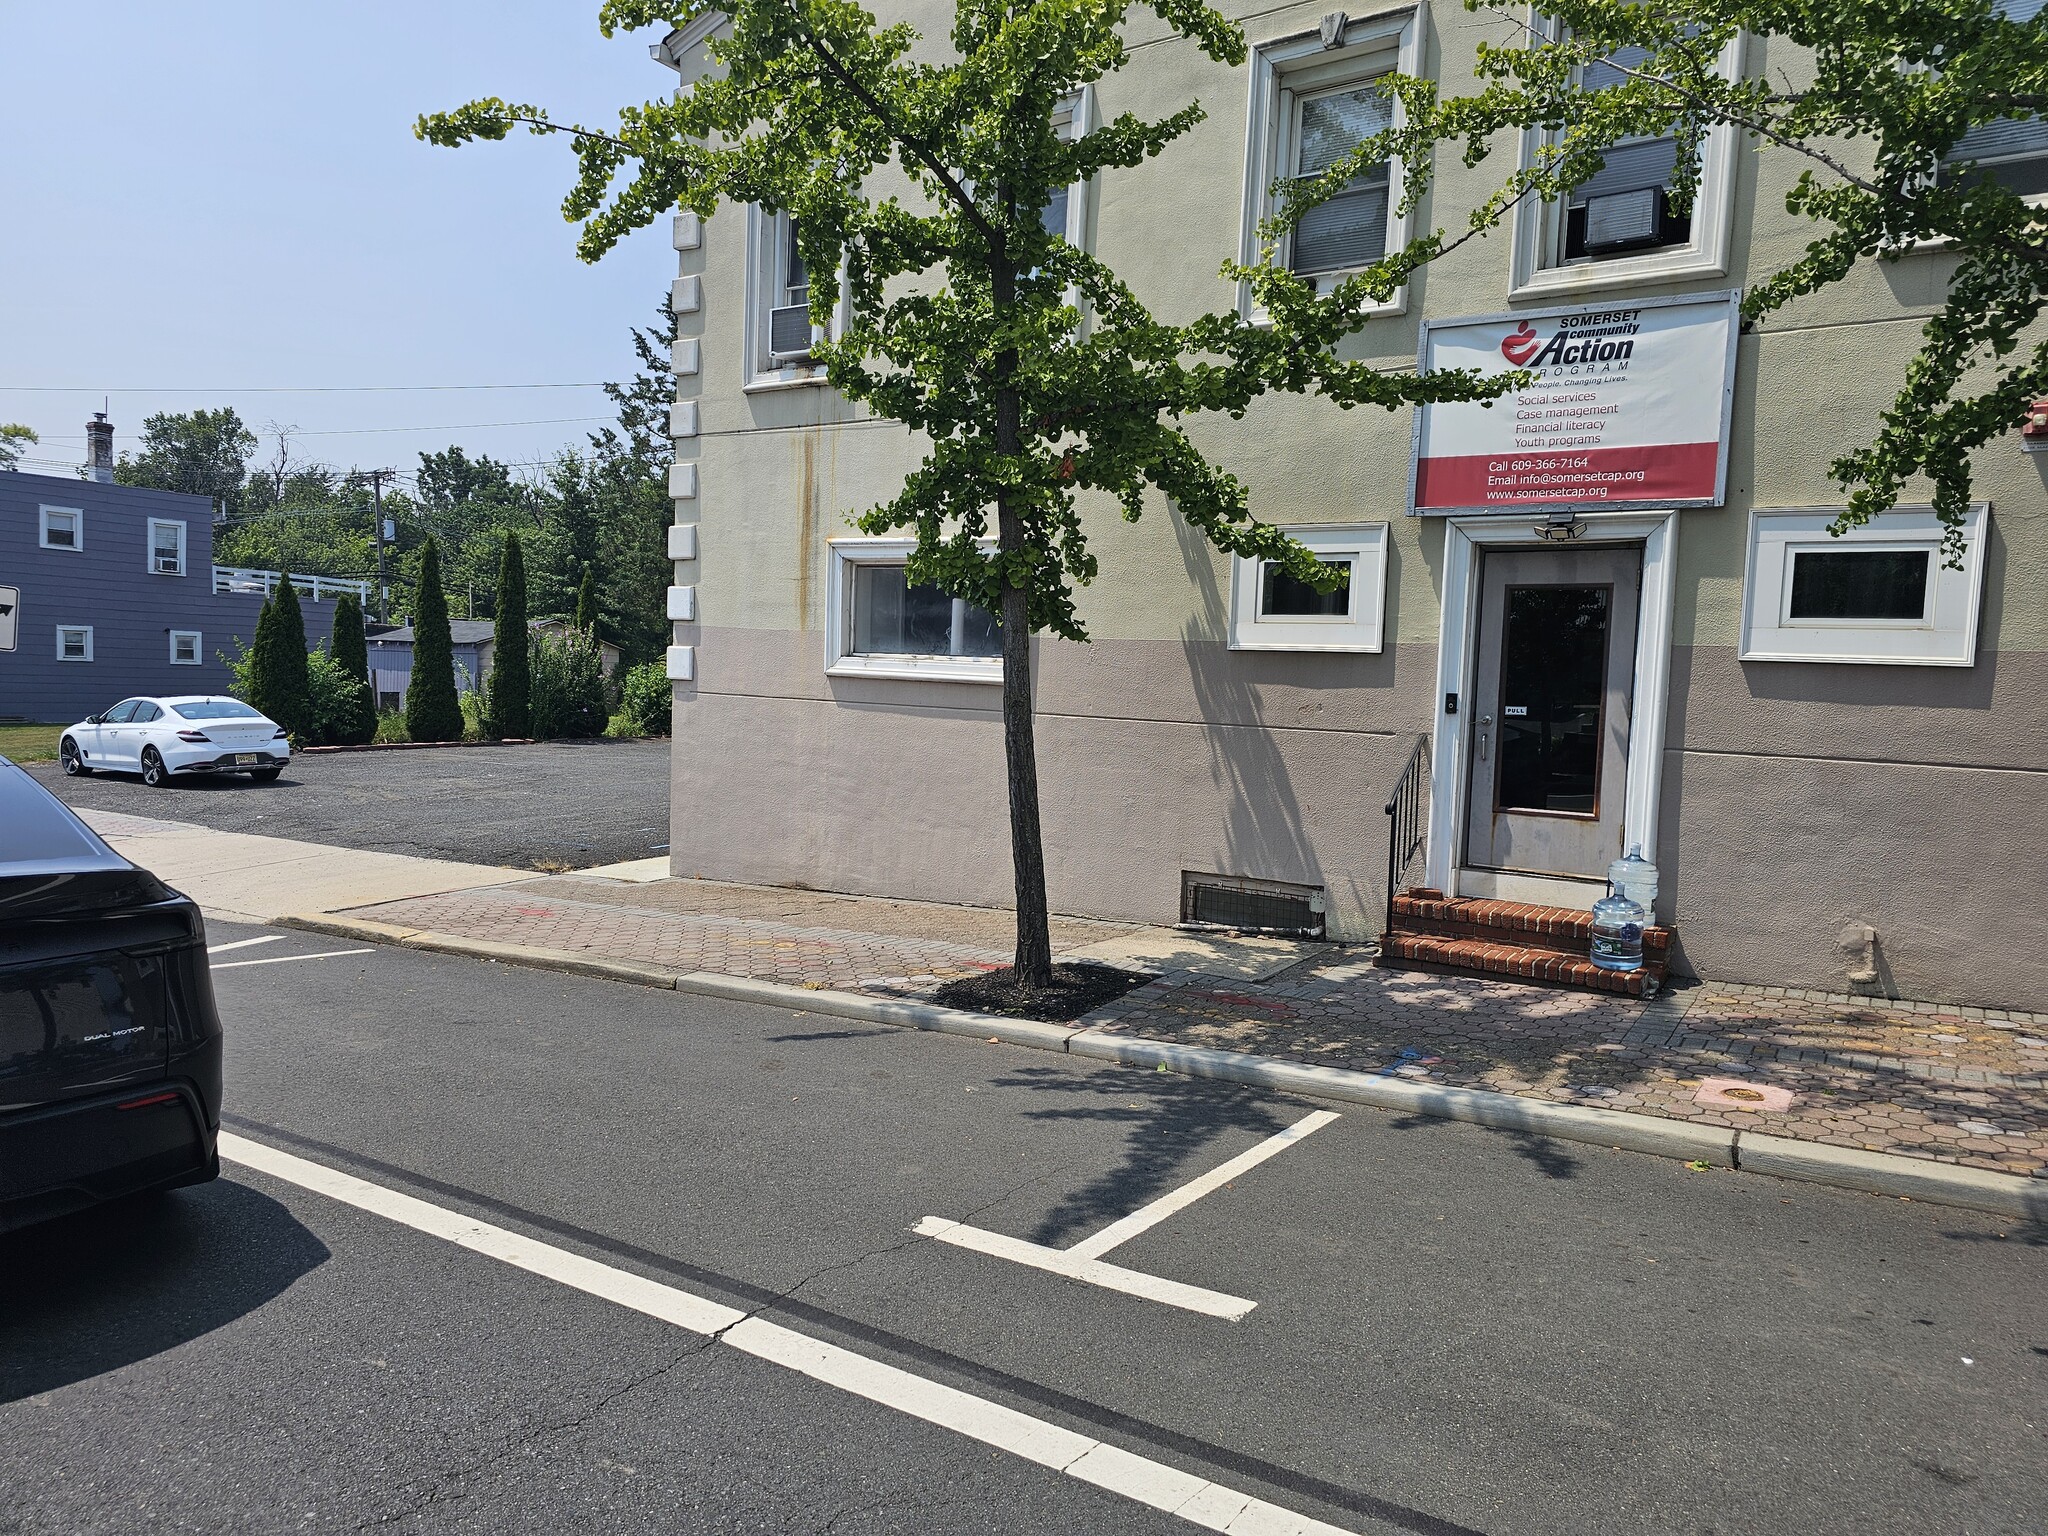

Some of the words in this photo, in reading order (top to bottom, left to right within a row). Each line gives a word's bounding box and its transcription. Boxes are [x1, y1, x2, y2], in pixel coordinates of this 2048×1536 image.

[1560, 310, 1642, 328] SOMERSET
[1569, 322, 1641, 339] community
[1527, 330, 1635, 368] Action
[1539, 361, 1629, 378] ROGRAM
[1564, 376, 1601, 387] Changing
[1604, 375, 1629, 383] Lives.
[1517, 394, 1549, 406] Social
[1552, 391, 1597, 404] services
[1516, 409, 1542, 420] Case
[1545, 404, 1619, 420] management
[1515, 420, 1562, 434] Financial
[1566, 419, 1606, 431] literacy
[1514, 436, 1545, 448] Youth
[1548, 434, 1601, 448] programs
[1489, 460, 1508, 472] Call
[1511, 457, 1588, 471] 609-366-7164
[1487, 474, 1517, 486] Email
[1520, 470, 1645, 485] info@somersetcap.org
[1486, 486, 1608, 499] www.somersetcap.org
[84, 1033, 111, 1041] DUAL
[112, 1026, 145, 1036] MOTOR
